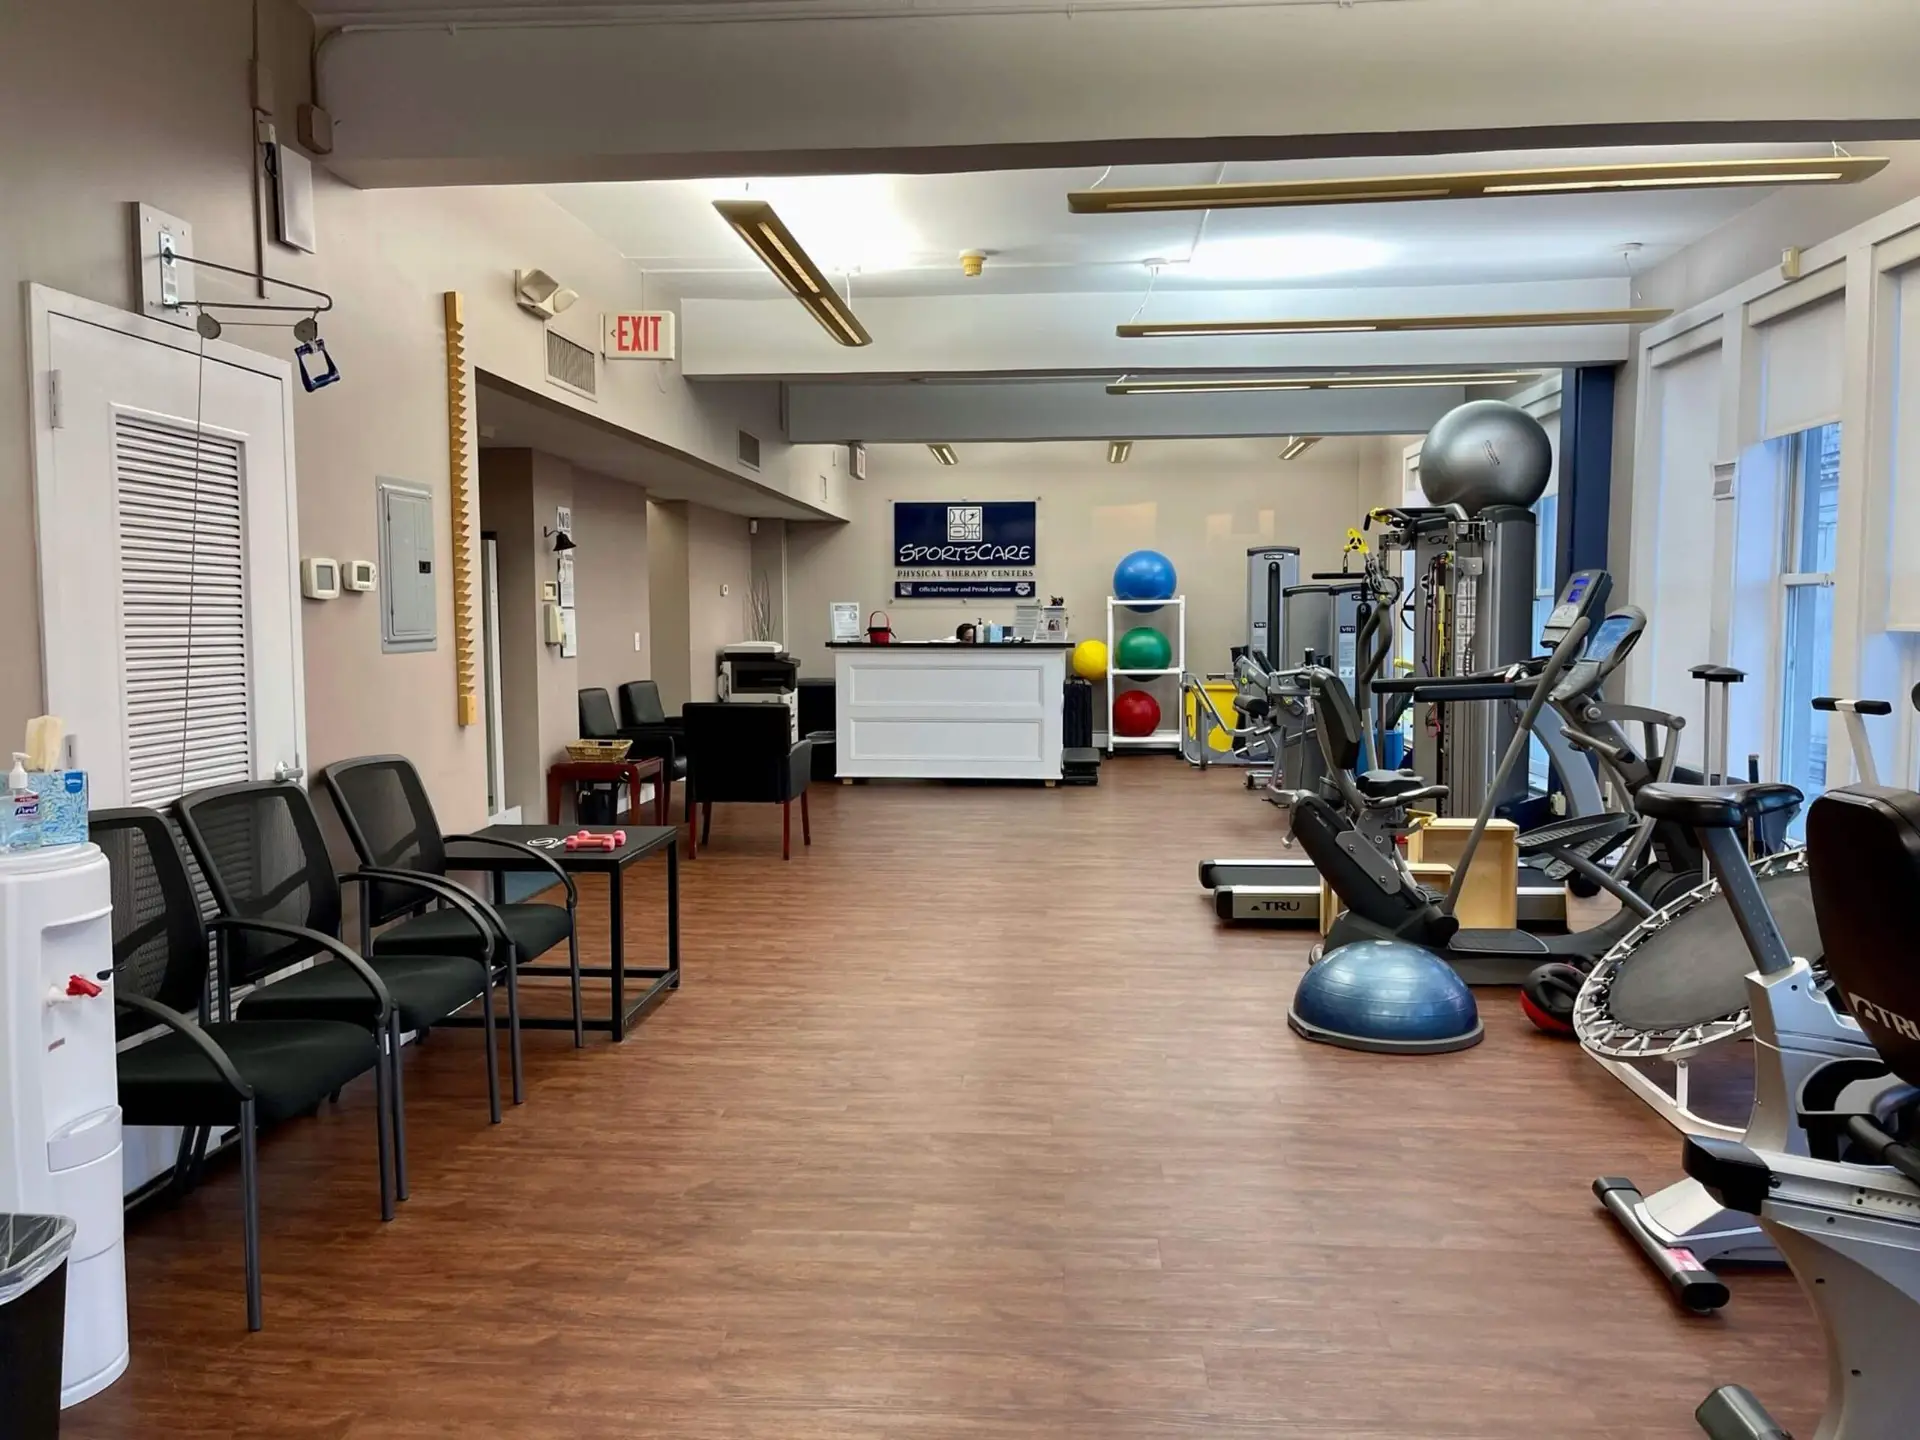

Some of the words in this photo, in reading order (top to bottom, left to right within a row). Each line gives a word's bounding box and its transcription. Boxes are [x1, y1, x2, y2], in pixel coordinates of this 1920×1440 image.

[617, 315, 662, 352] EXIT
[897, 569, 943, 577] PHYSICAL
[945, 569, 989, 577] THERAPY
[991, 569, 1034, 577] CENTERS
[1260, 901, 1300, 911] TRU
